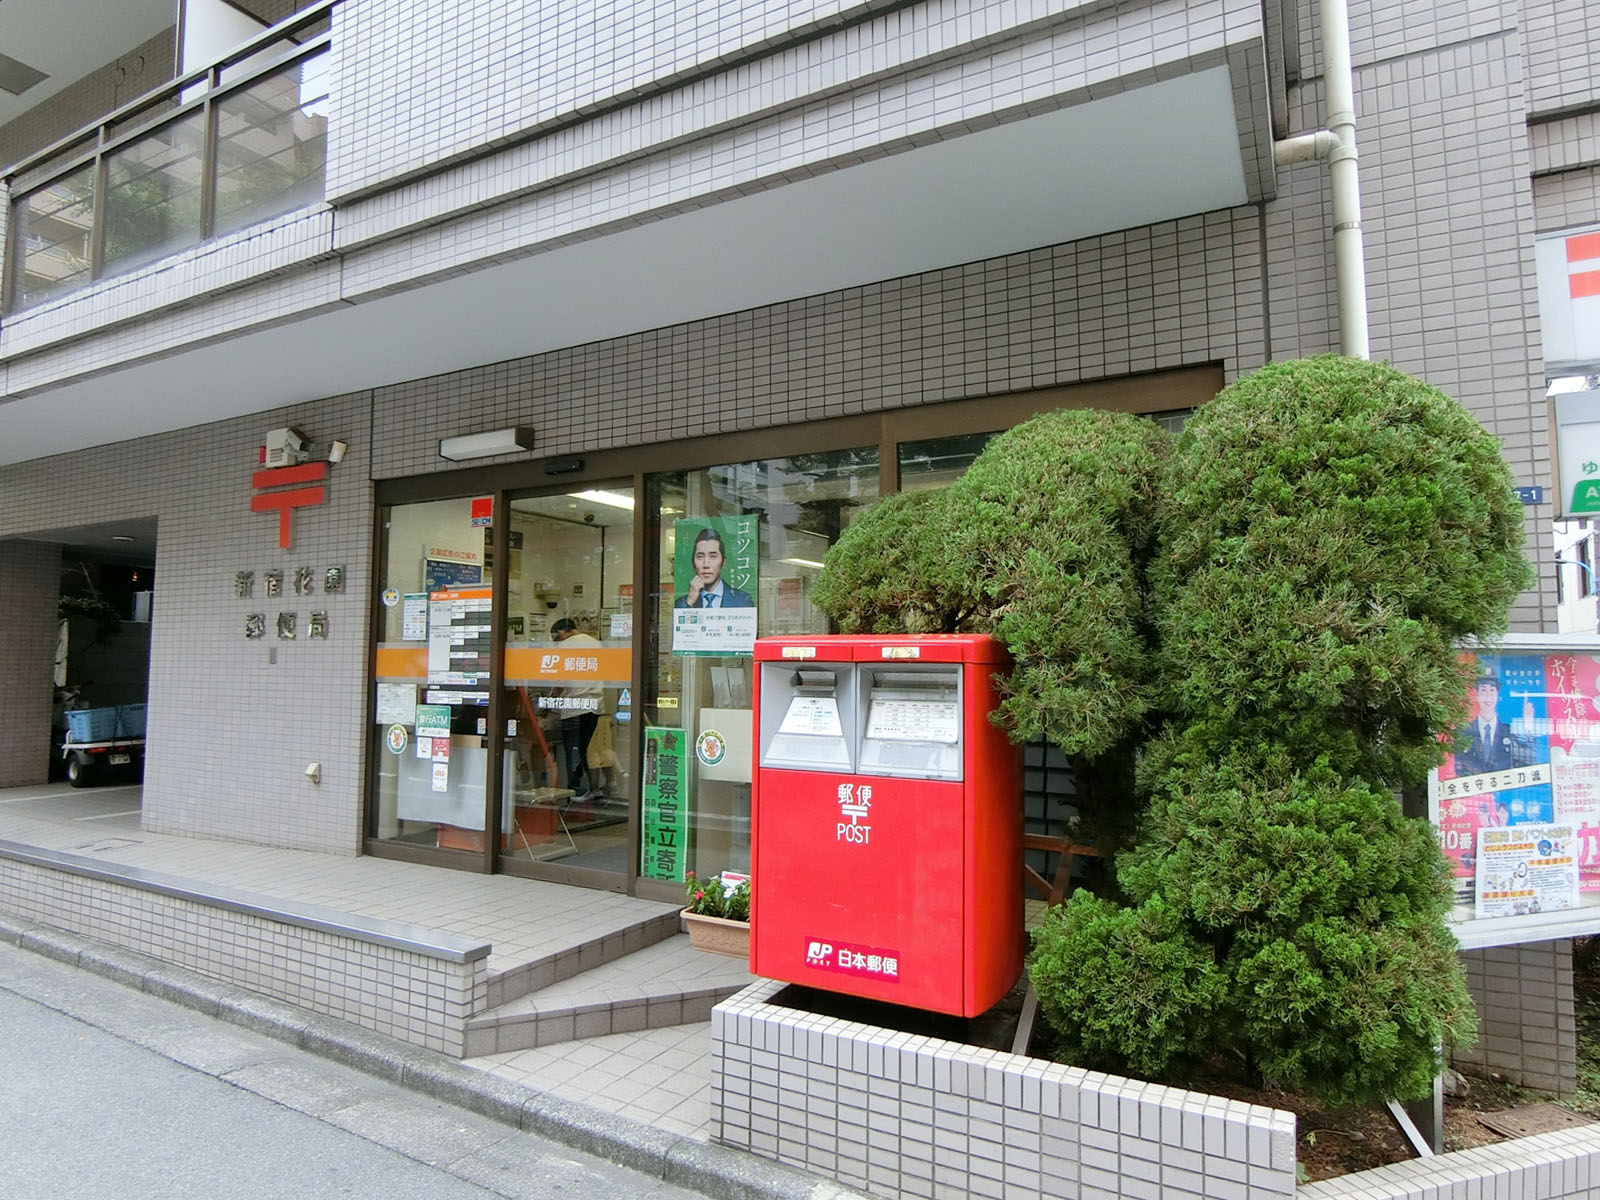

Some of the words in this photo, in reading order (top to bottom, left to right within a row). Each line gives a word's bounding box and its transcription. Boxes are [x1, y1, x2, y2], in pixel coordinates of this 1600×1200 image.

[1585, 485, 1600, 498] A
[736, 521, 752, 590] コツコツ
[234, 566, 345, 598] 新宿花園
[245, 609, 329, 640] 郵便局
[564, 657, 598, 671] 郵便局
[538, 697, 598, 710] 新宿花園郵便局
[837, 783, 872, 807] 郵便
[1438, 770, 1541, 797] 全を守る二刀流
[656, 753, 679, 880] 警察官立寄
[837, 823, 871, 844] POST
[807, 941, 833, 959] JP
[838, 948, 898, 977] 日本郵便
